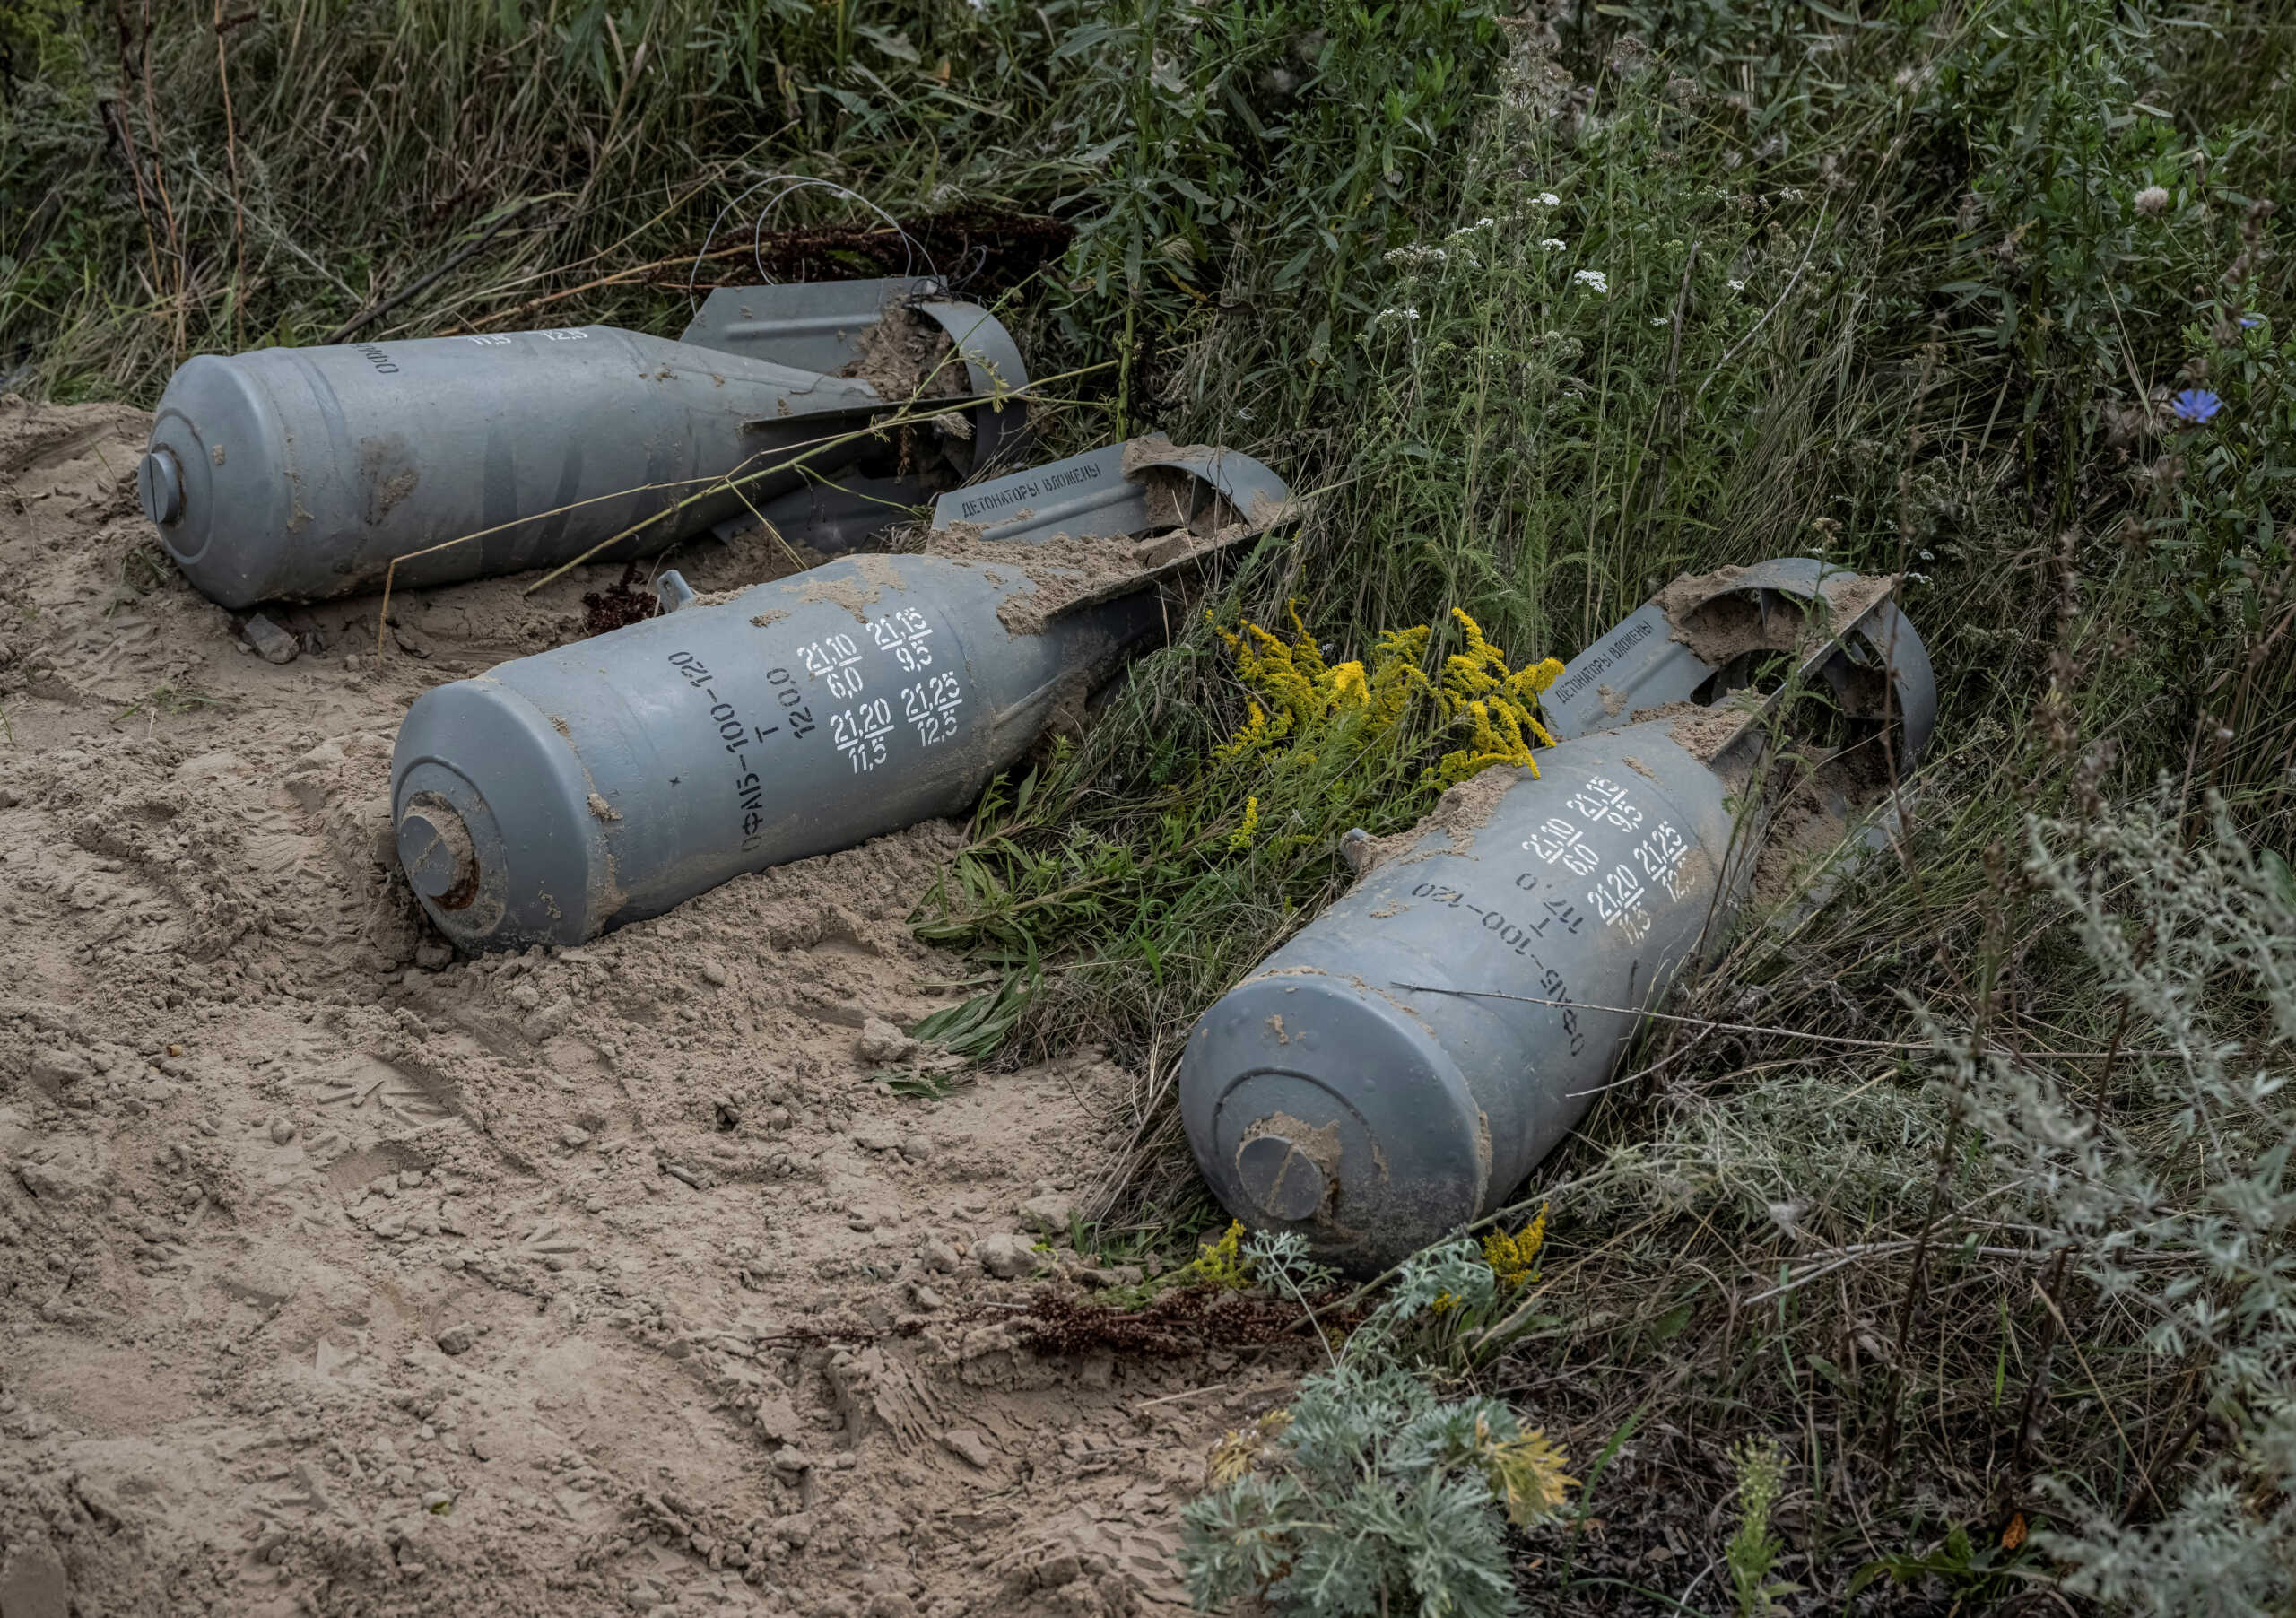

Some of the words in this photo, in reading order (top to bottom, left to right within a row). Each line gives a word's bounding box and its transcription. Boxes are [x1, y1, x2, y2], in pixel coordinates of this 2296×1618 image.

[961, 483, 1040, 518] ДЕТОНАТОРЫ
[1042, 463, 1102, 493] ВЛОЖЕНЫ
[866, 607, 926, 646] 21,15
[797, 633, 857, 672] 21,10
[896, 639, 933, 672] 9,5
[1554, 653, 1614, 704] ДЕТОНАТОРЫ
[1609, 619, 1654, 661] ВЛОЖЕНЫ
[826, 665, 864, 699] 6,0
[900, 671, 961, 718] 21,25
[830, 698, 891, 745] 21,20
[917, 709, 958, 747] 12,5
[848, 735, 887, 775] 11,5
[1566, 775, 1619, 819] 21,15
[1607, 800, 1643, 832] 9,5
[1522, 817, 1576, 860] 21,10
[1562, 843, 1600, 876] 6,0
[1633, 820, 1683, 874] 21,25
[1587, 863, 1639, 921] 21,20
[1618, 900, 1651, 946] 11,5
